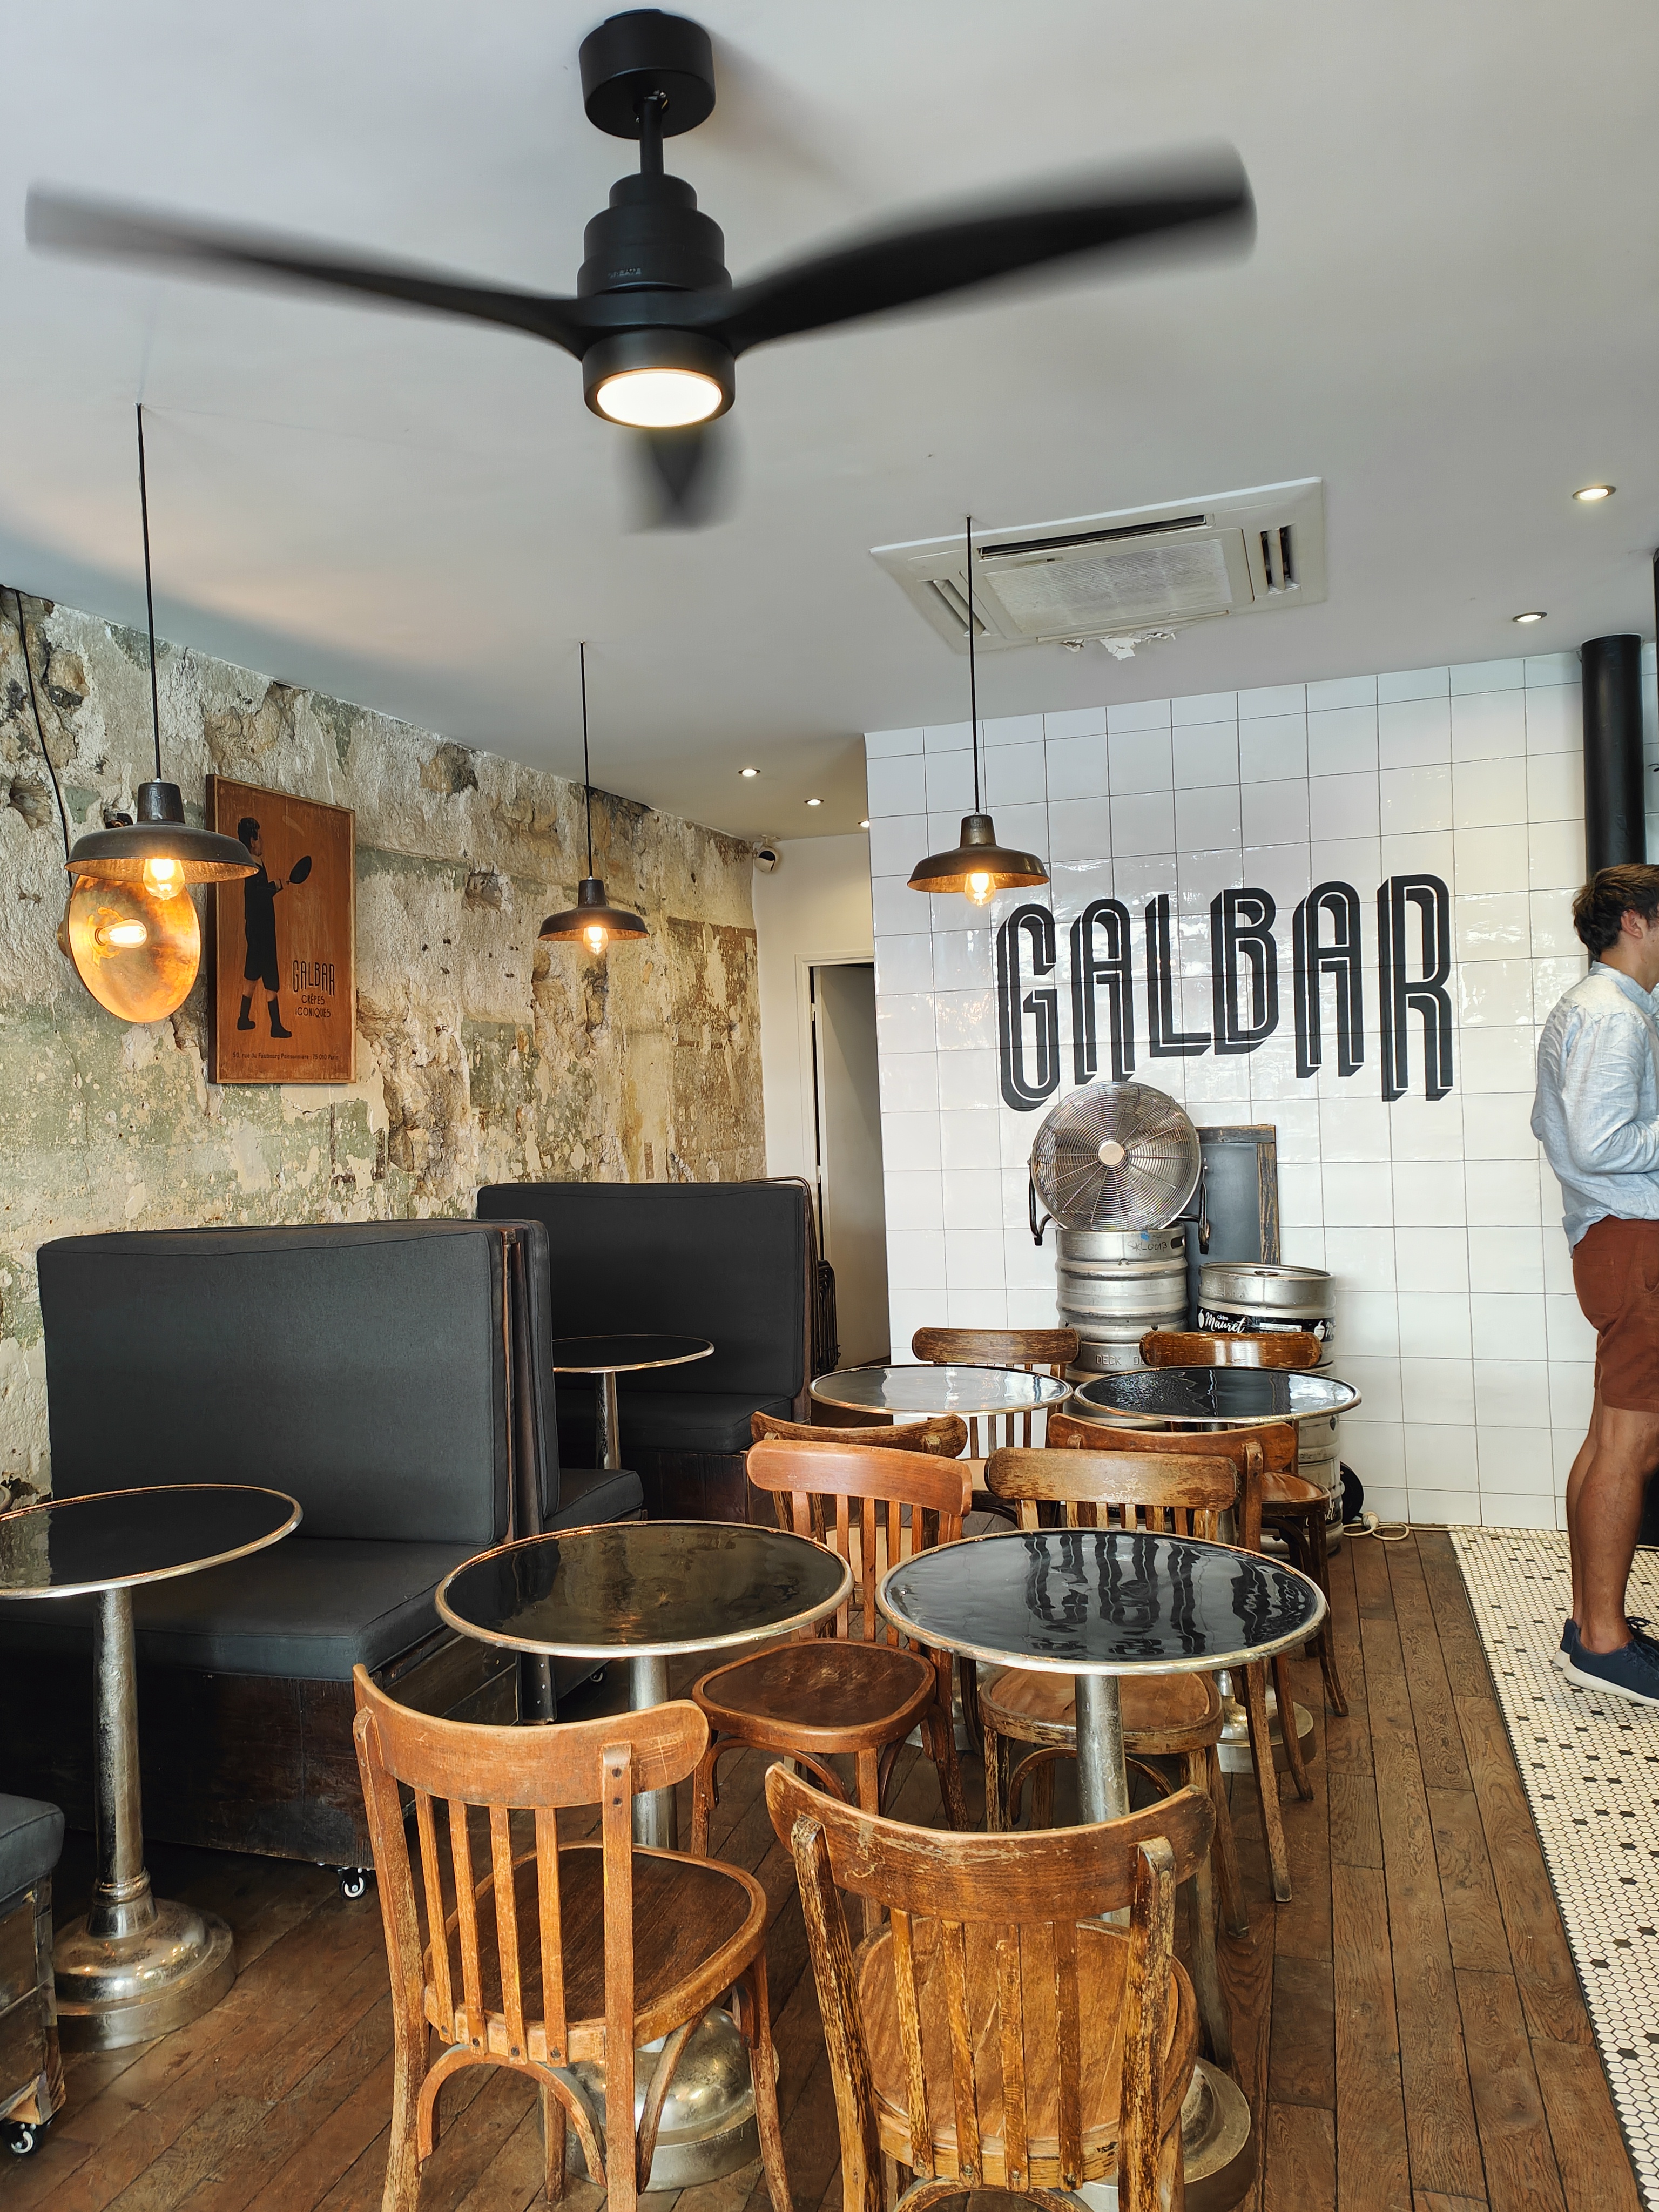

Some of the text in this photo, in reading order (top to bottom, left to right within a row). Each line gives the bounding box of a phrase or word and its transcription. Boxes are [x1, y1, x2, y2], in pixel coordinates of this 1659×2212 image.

[293, 960, 335, 995] GALBAR
[301, 993, 325, 1005] CRÊPES
[996, 874, 1454, 1111] GALBAR
[295, 1007, 331, 1018] ICONIQUES
[1205, 1312, 1246, 1334] Mauret
[1096, 1354, 1122, 1366] DECK
